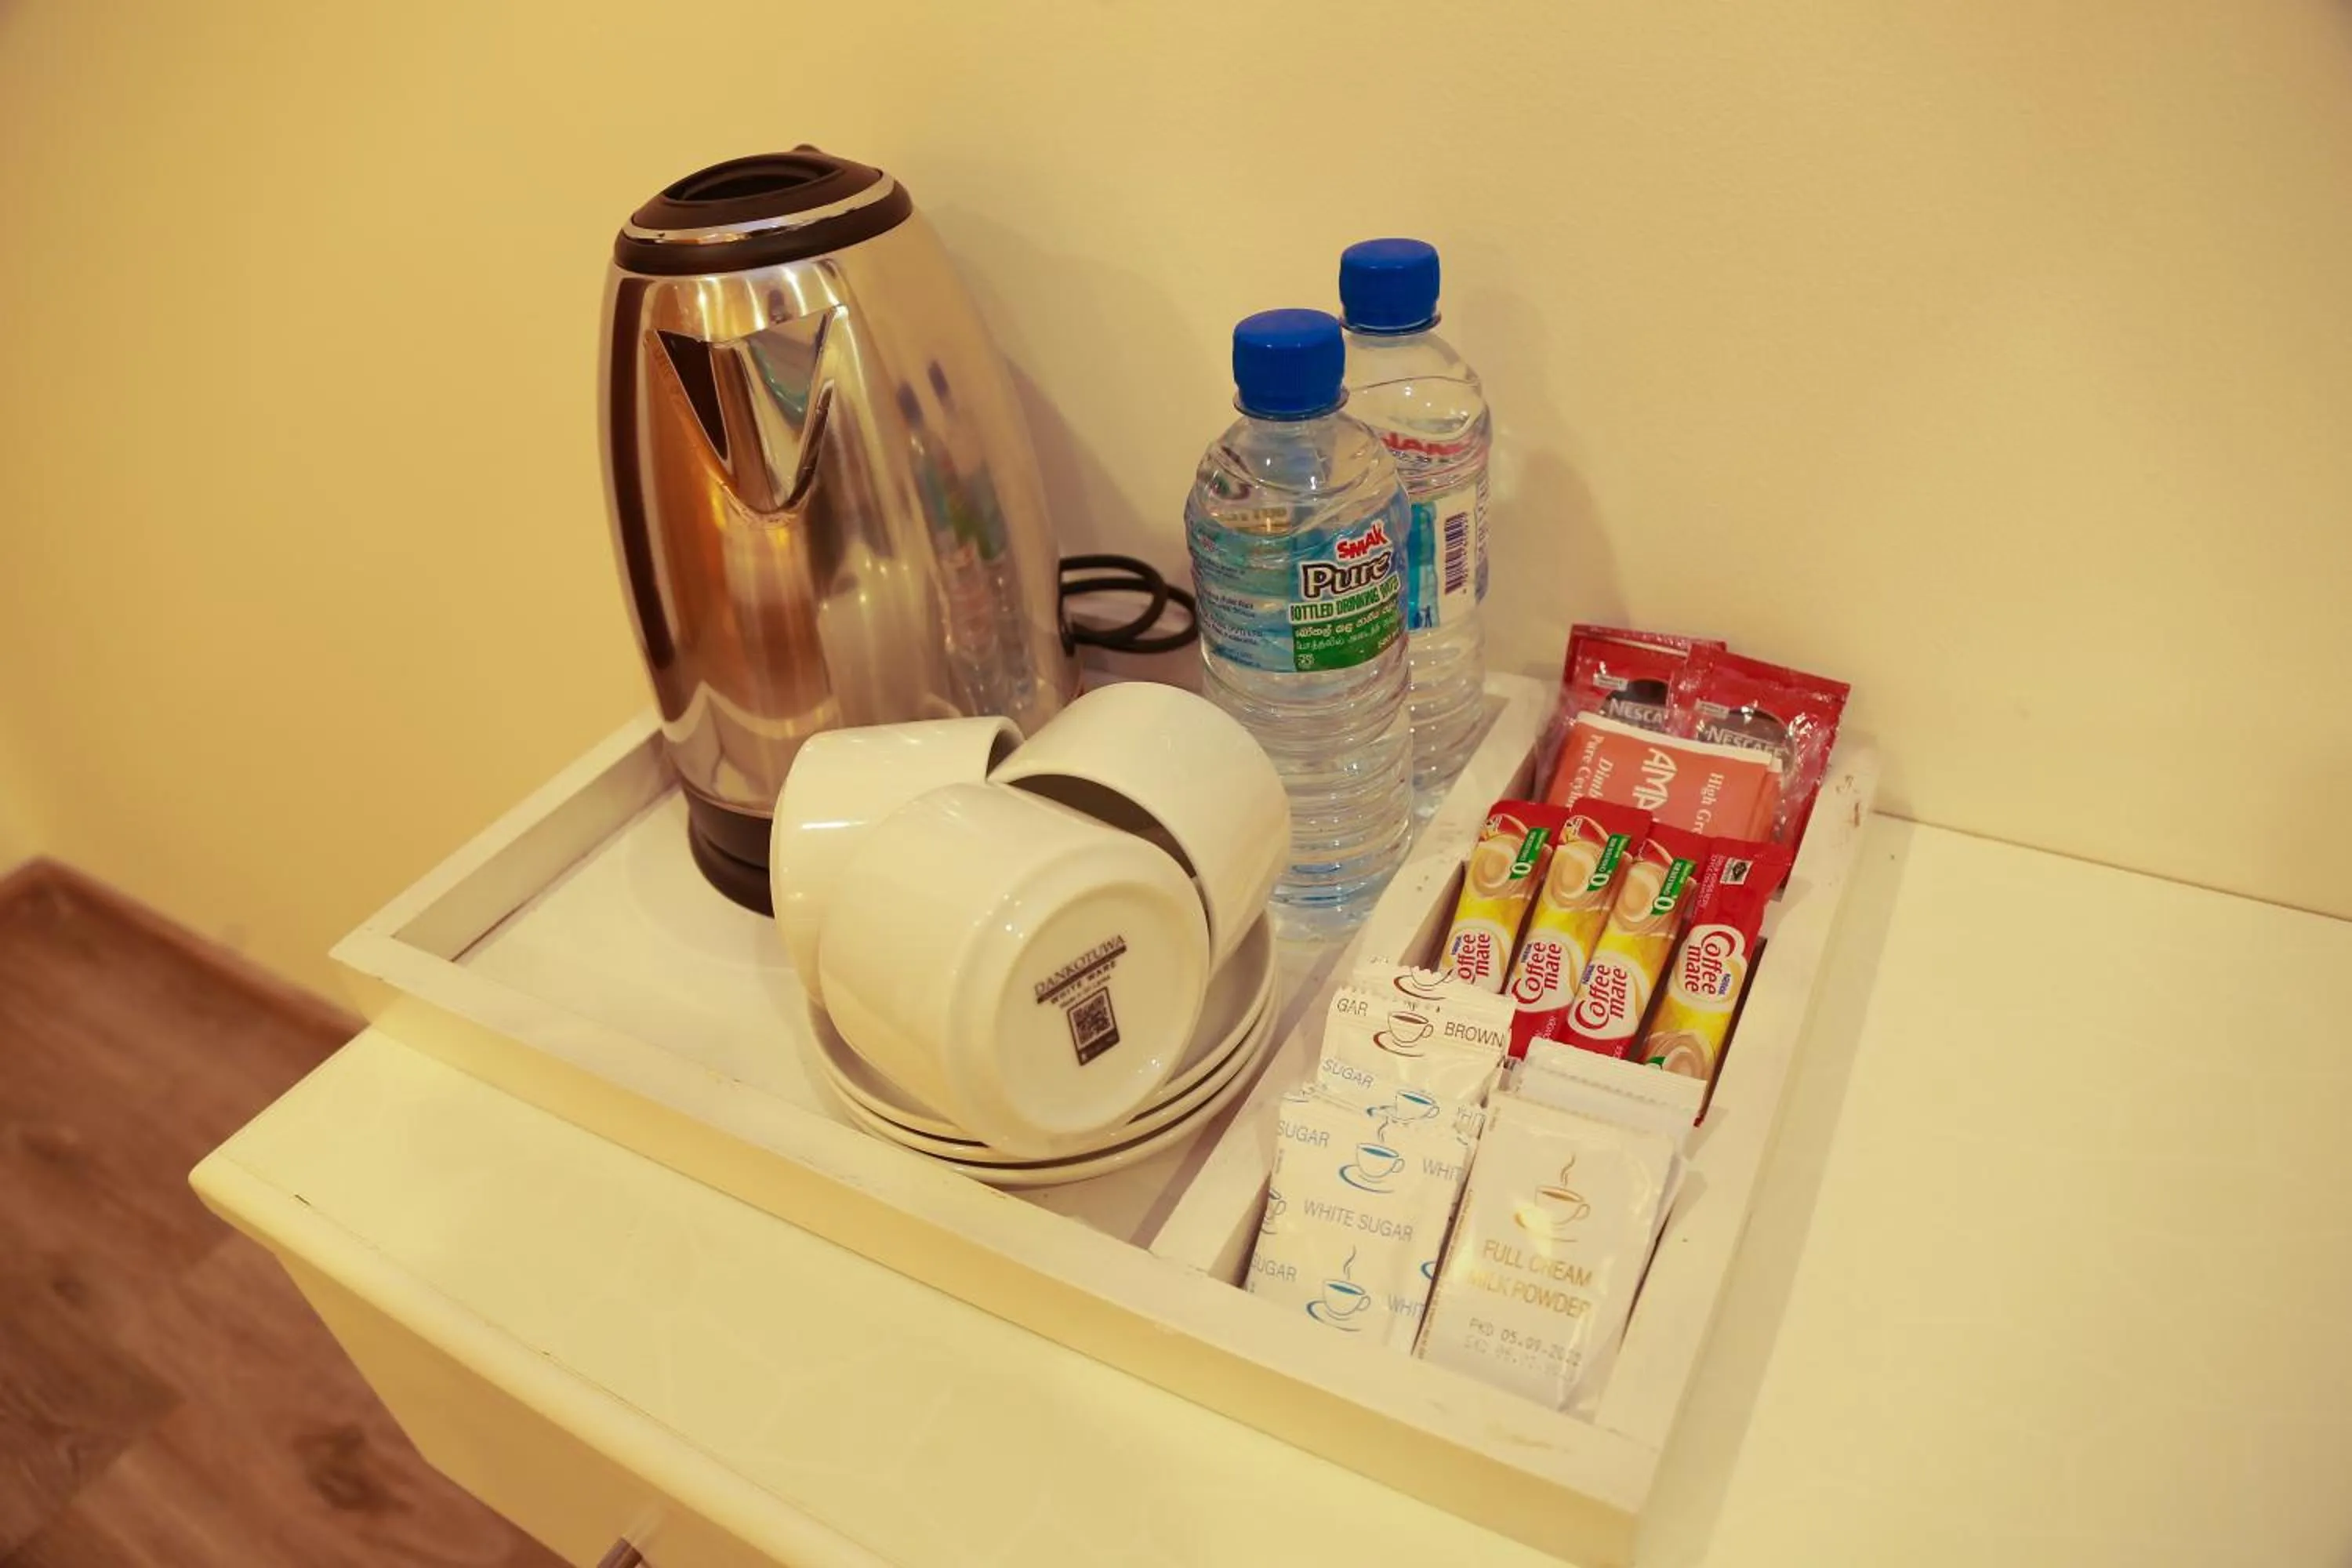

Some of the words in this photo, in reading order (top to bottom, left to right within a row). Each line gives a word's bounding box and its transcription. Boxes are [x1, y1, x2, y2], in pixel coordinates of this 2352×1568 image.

[1336, 523, 1388, 559] SMAK
[1301, 550, 1392, 599] Pure
[1700, 771, 1724, 806] High
[1457, 933, 1476, 985] offee
[1475, 933, 1491, 978] mate
[1511, 941, 1547, 1004] Coffee
[1544, 942, 1563, 991] mate
[1684, 944, 1700, 993] mate
[1700, 931, 1737, 995] Coffee
[1574, 964, 1611, 1029] Coffee
[1610, 966, 1628, 1021] mate
[1336, 996, 1368, 1017] GAR
[1444, 1021, 1504, 1049] BROWN
[1321, 1058, 1374, 1088] SUGAR
[1422, 1158, 1463, 1181] WHIT
[1303, 1199, 1355, 1229] WHITE
[1356, 1214, 1414, 1243] SUGAR
[1483, 1239, 1523, 1269] FULL
